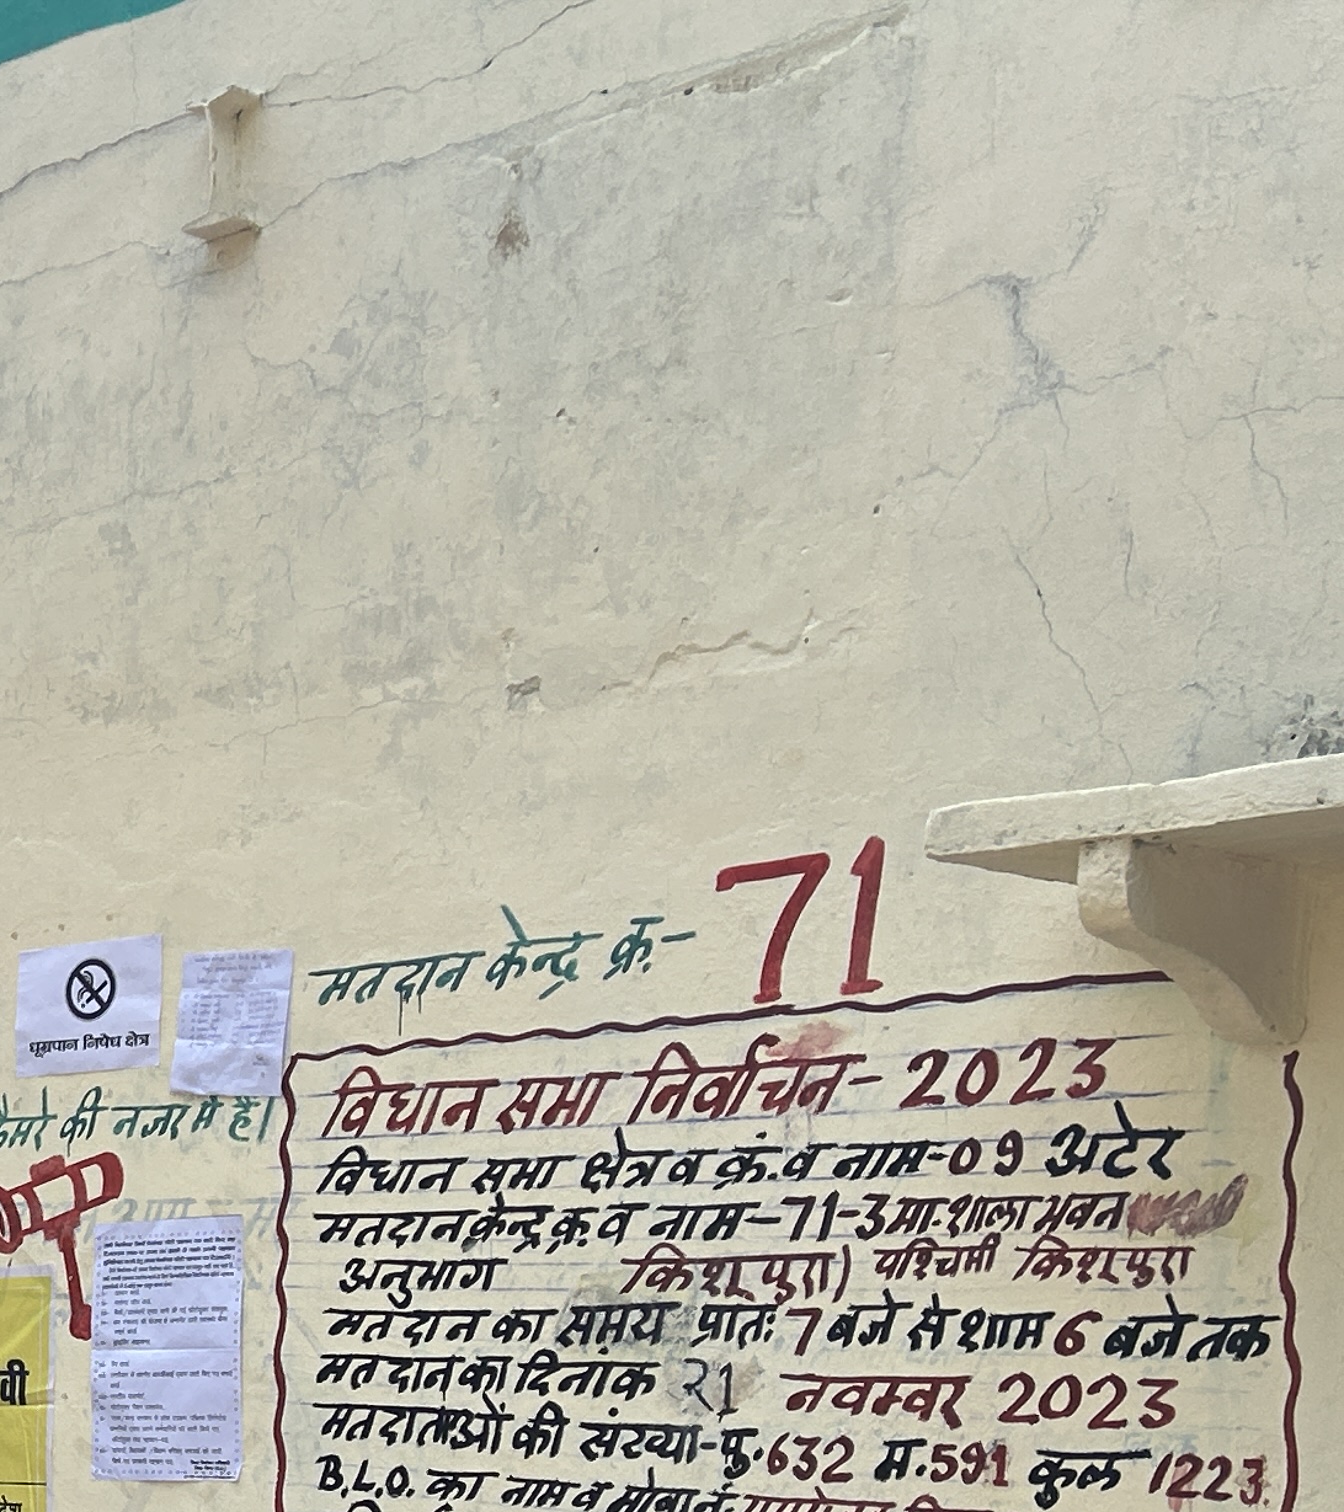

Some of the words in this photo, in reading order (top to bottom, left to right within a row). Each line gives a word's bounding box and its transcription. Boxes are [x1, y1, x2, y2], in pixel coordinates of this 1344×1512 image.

[309, 953, 484, 1005] मतदान
[716, 835, 885, 1003] 71
[124, 1031, 150, 1047] क्षेत्र
[61, 1087, 109, 1140] की
[111, 1103, 185, 1139] नजर
[322, 1066, 499, 1137] विधान
[497, 1072, 622, 1134] सभा
[899, 1037, 1116, 1109] 2023
[316, 1145, 468, 1195] विधान
[472, 1155, 575, 1194] सभा
[581, 1127, 674, 1193] क्षेत्र
[670, 1149, 718, 1185] व
[1045, 1099, 1185, 1179] अटेर
[313, 1209, 480, 1247] मतदान
[598, 1201, 648, 1246] व
[1032, 1192, 1131, 1233] भवन
[339, 1258, 508, 1308] अनुभाग
[323, 1308, 490, 1347] मतदान
[492, 1309, 558, 1347] का
[557, 1302, 681, 1347] समय
[786, 1308, 822, 1356] 7
[907, 1293, 961, 1350] से
[961, 1310, 1054, 1352] शाम
[1054, 1311, 1103, 1356] 6
[1187, 1317, 1280, 1362] तक
[315, 1354, 465, 1398] मतदान
[460, 1356, 513, 1394] का
[998, 1373, 1178, 1430] 2023
[513, 1400, 570, 1459] की
[1028, 1449, 1152, 1508] कुल
[427, 1468, 499, 1500] का
[501, 1475, 581, 1507] नाम
[572, 1482, 614, 1511] व
